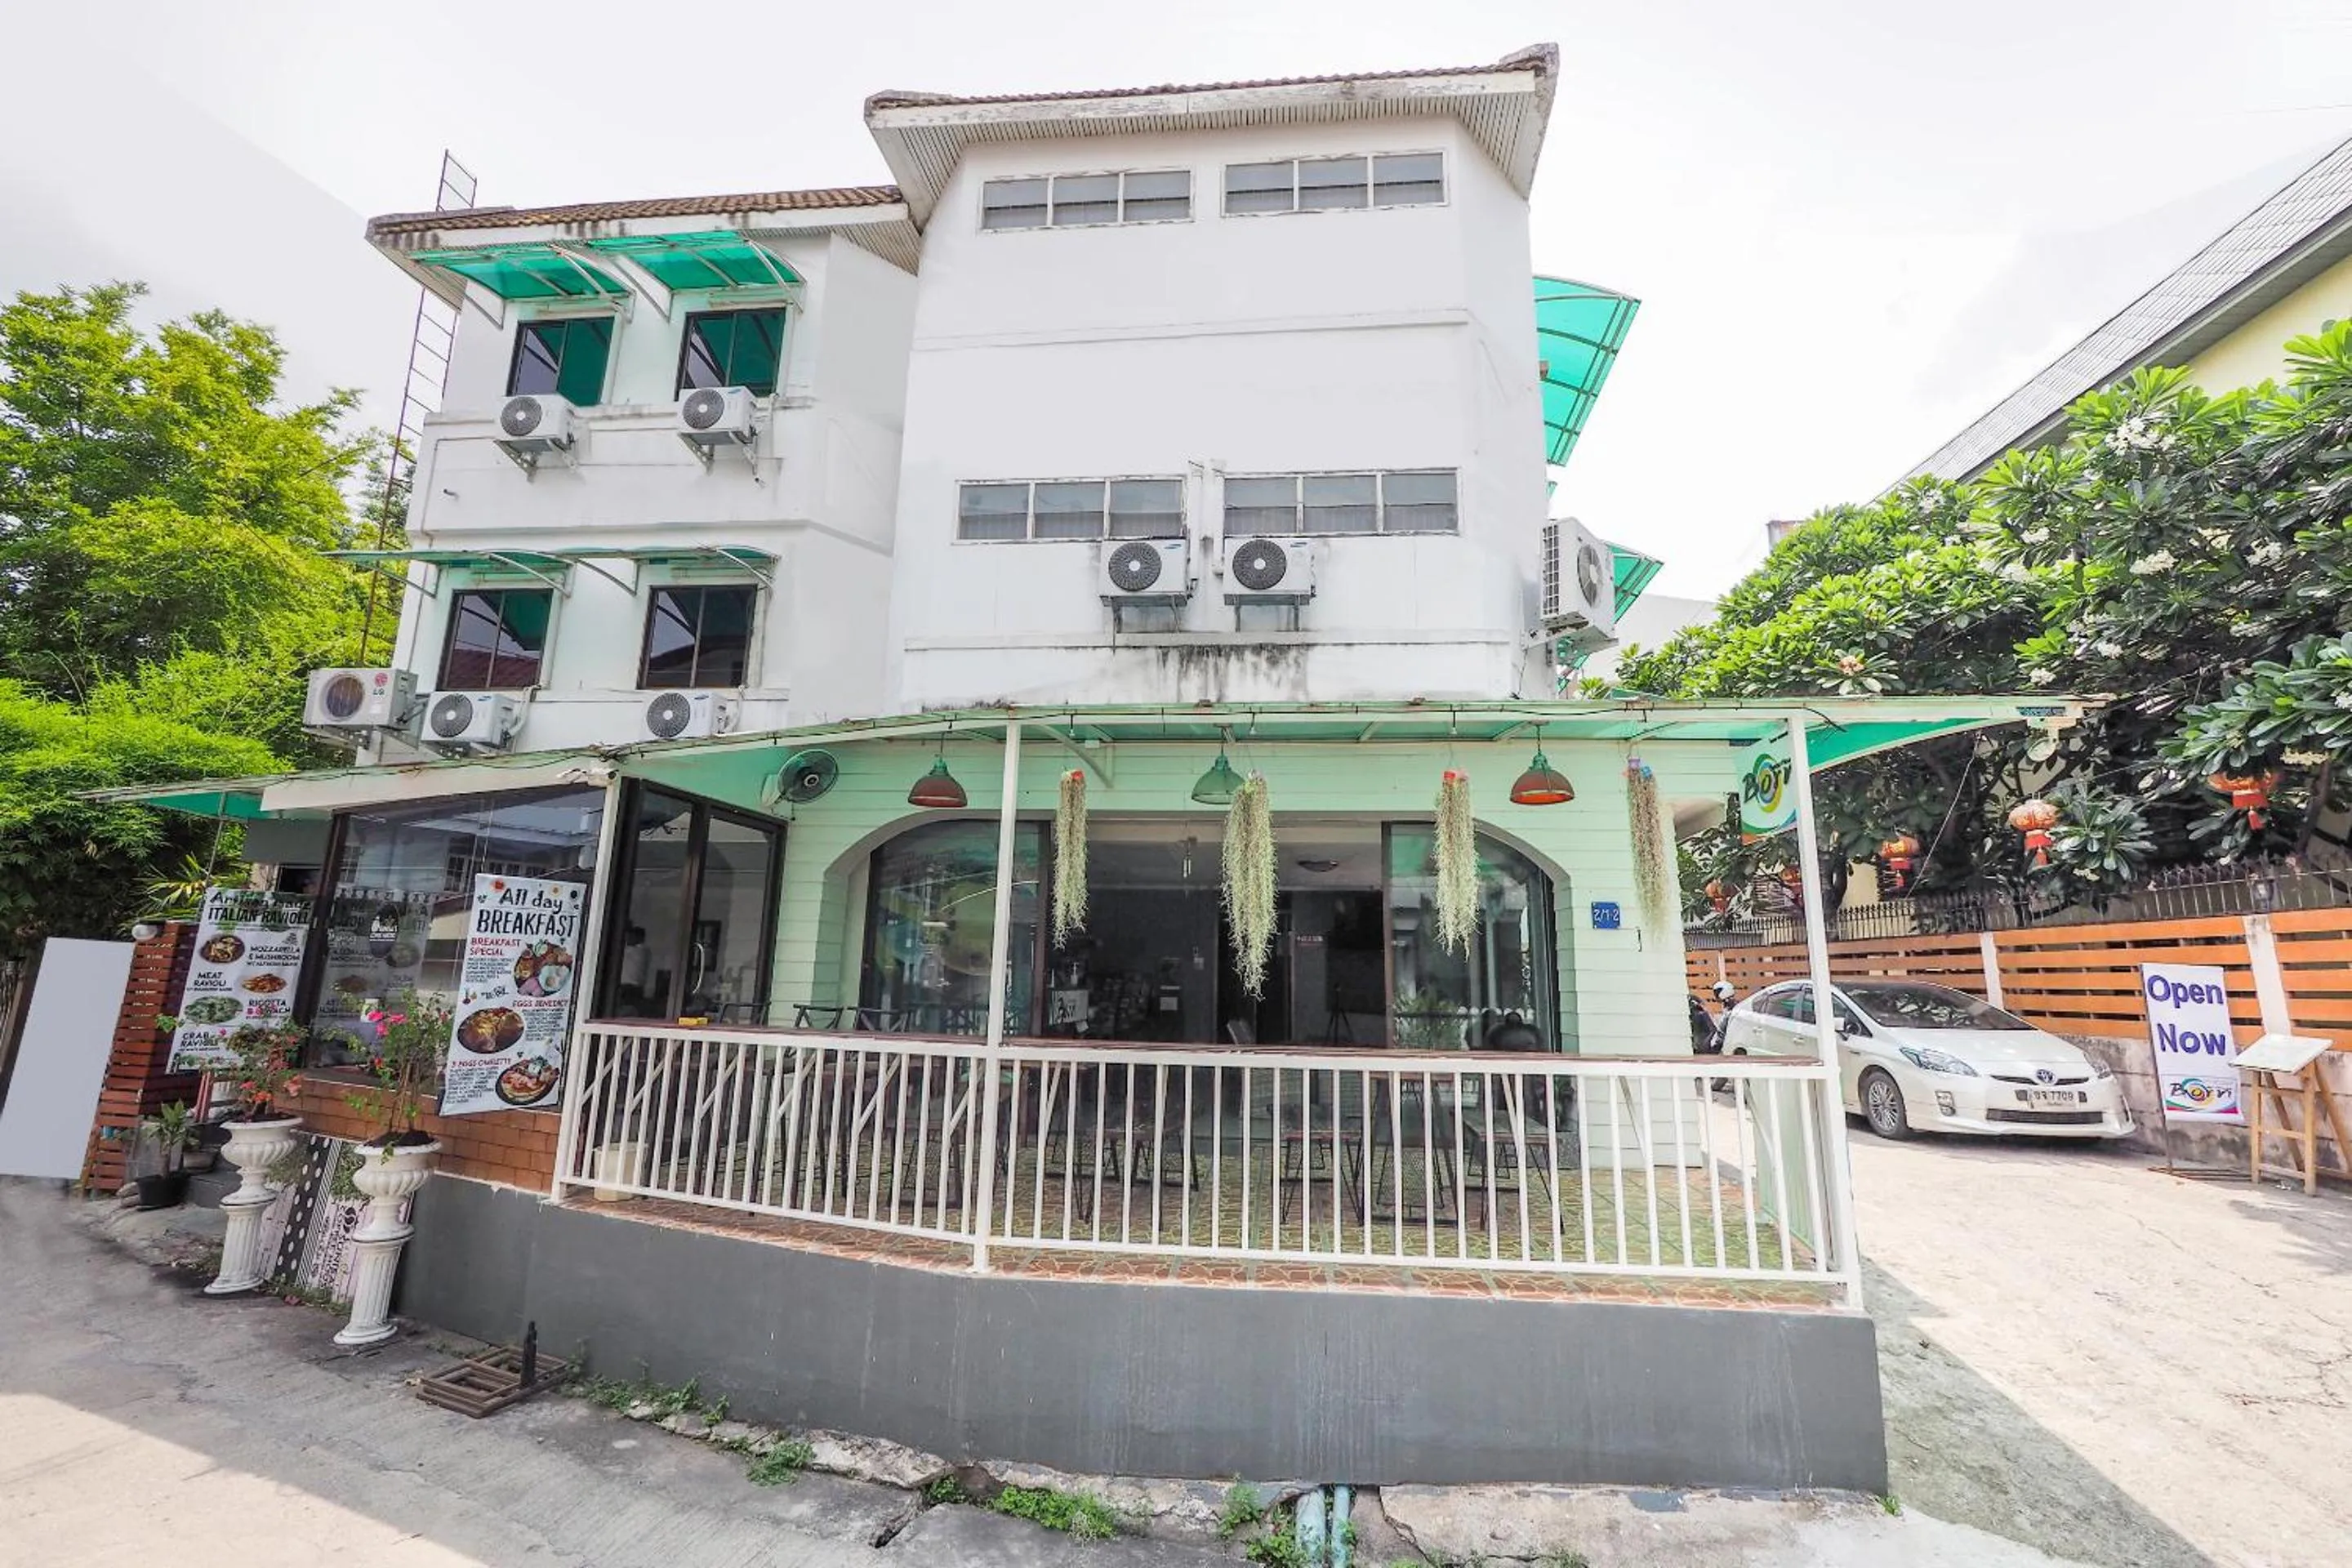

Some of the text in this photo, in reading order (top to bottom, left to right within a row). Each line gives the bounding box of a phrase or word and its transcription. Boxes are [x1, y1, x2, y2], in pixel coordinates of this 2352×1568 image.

[207, 907, 257, 922] ITALIAN
[499, 889, 564, 915] All day
[476, 909, 577, 938] BREAKFAST
[470, 937, 521, 947] BREAKFAST
[470, 947, 504, 956] SPECIAL
[2147, 974, 2224, 1009] Open
[2157, 1023, 2226, 1056] Now
